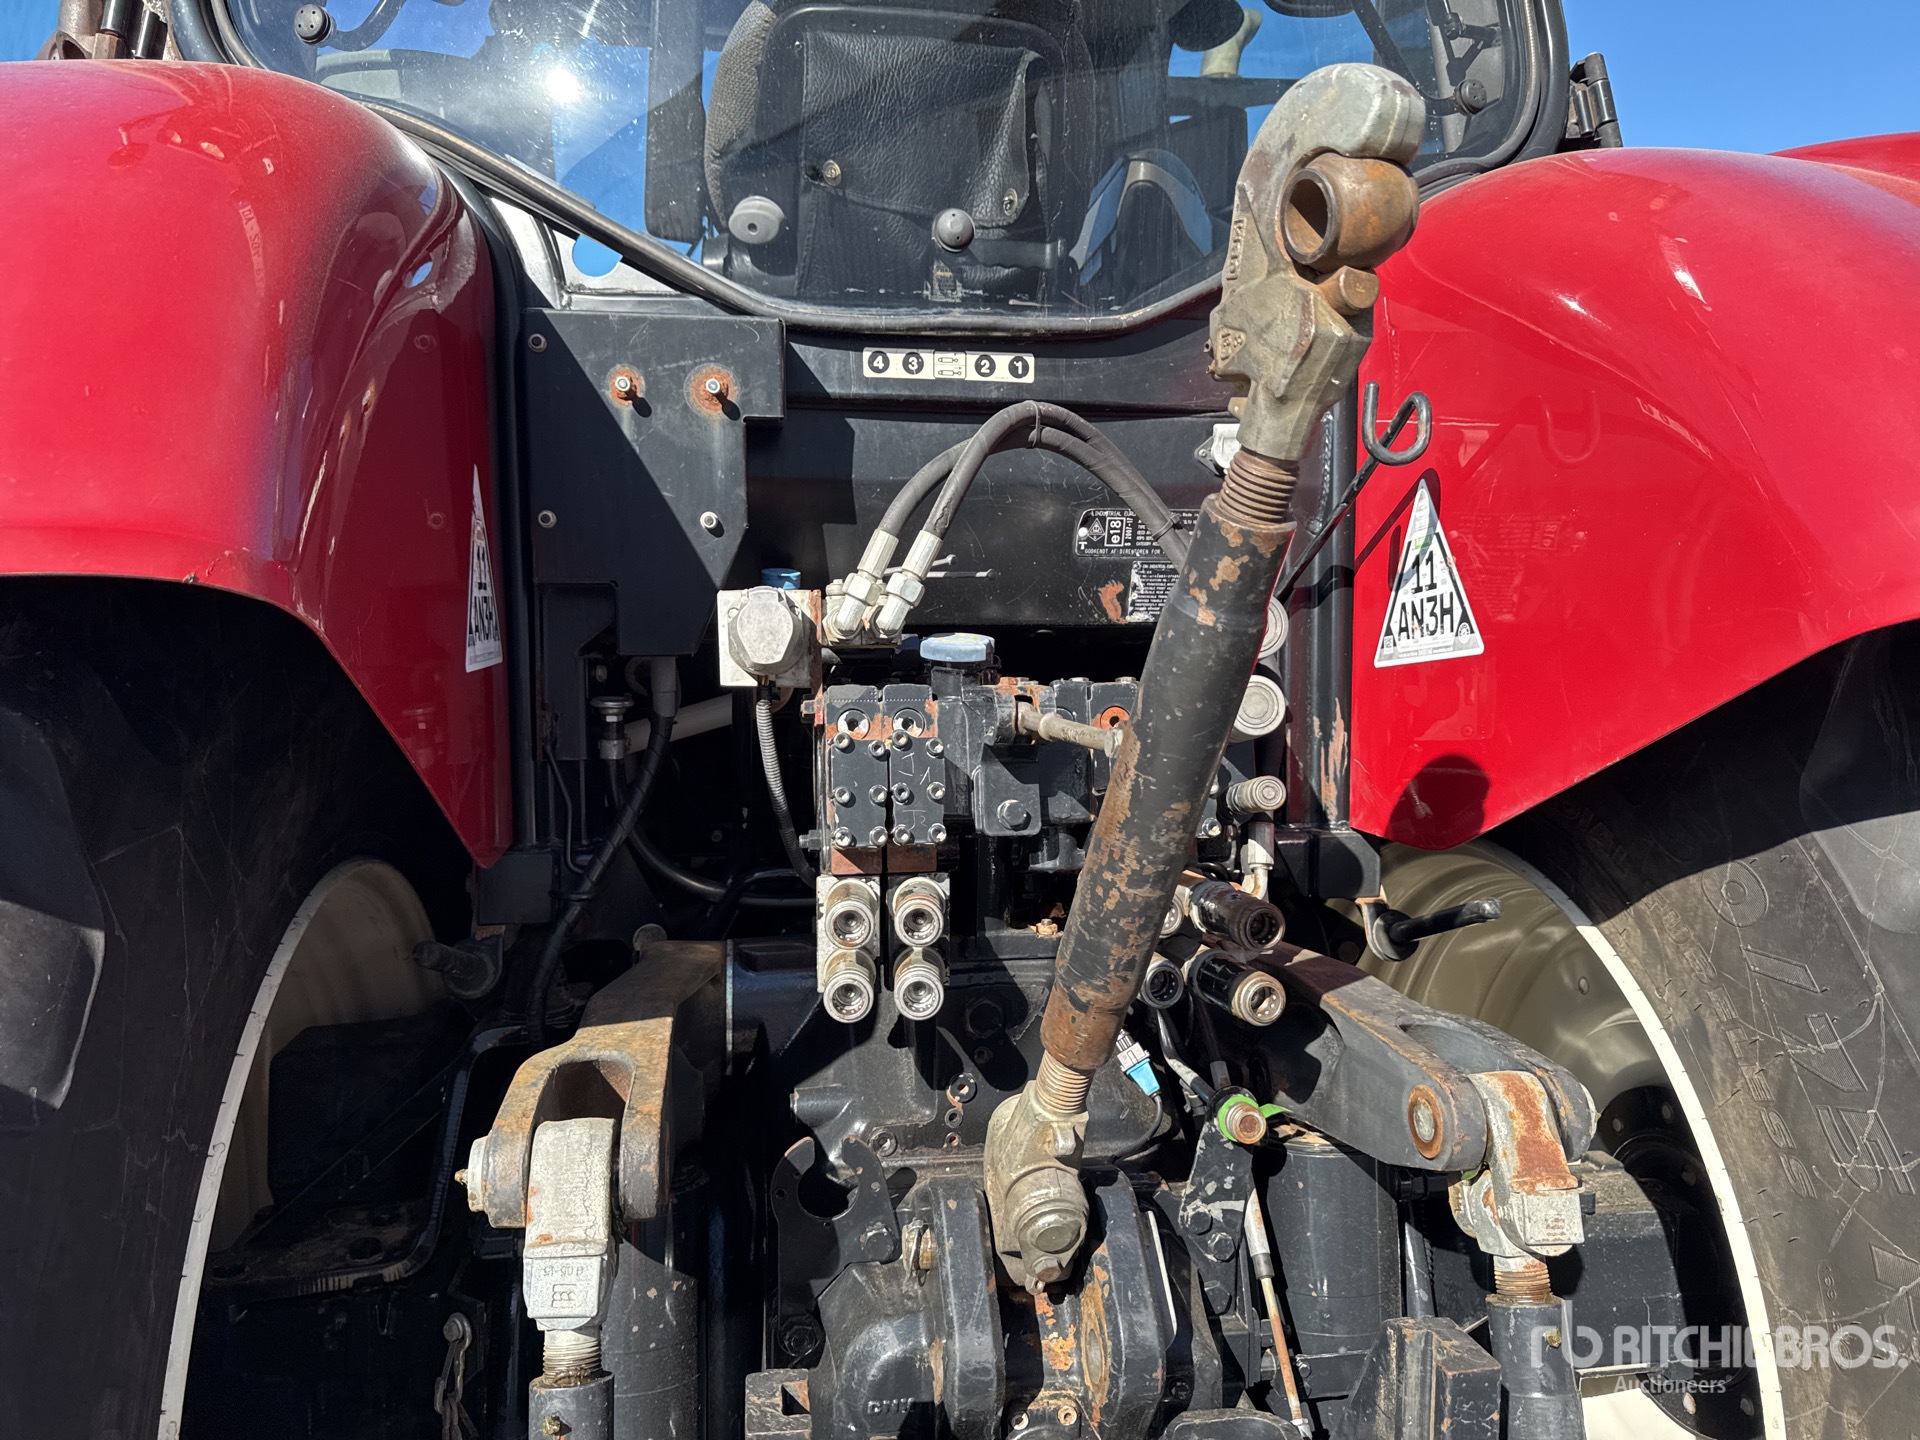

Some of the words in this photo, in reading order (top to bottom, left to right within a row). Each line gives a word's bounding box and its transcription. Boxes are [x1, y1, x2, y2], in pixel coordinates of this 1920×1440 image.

[873, 355, 885, 370] 4
[908, 356, 920, 371] 3
[980, 359, 990, 374] 2
[1014, 360, 1023, 375] 1
[1109, 520, 1122, 544] e18
[1410, 549, 1438, 594] 11
[1397, 591, 1455, 641] AN3H
